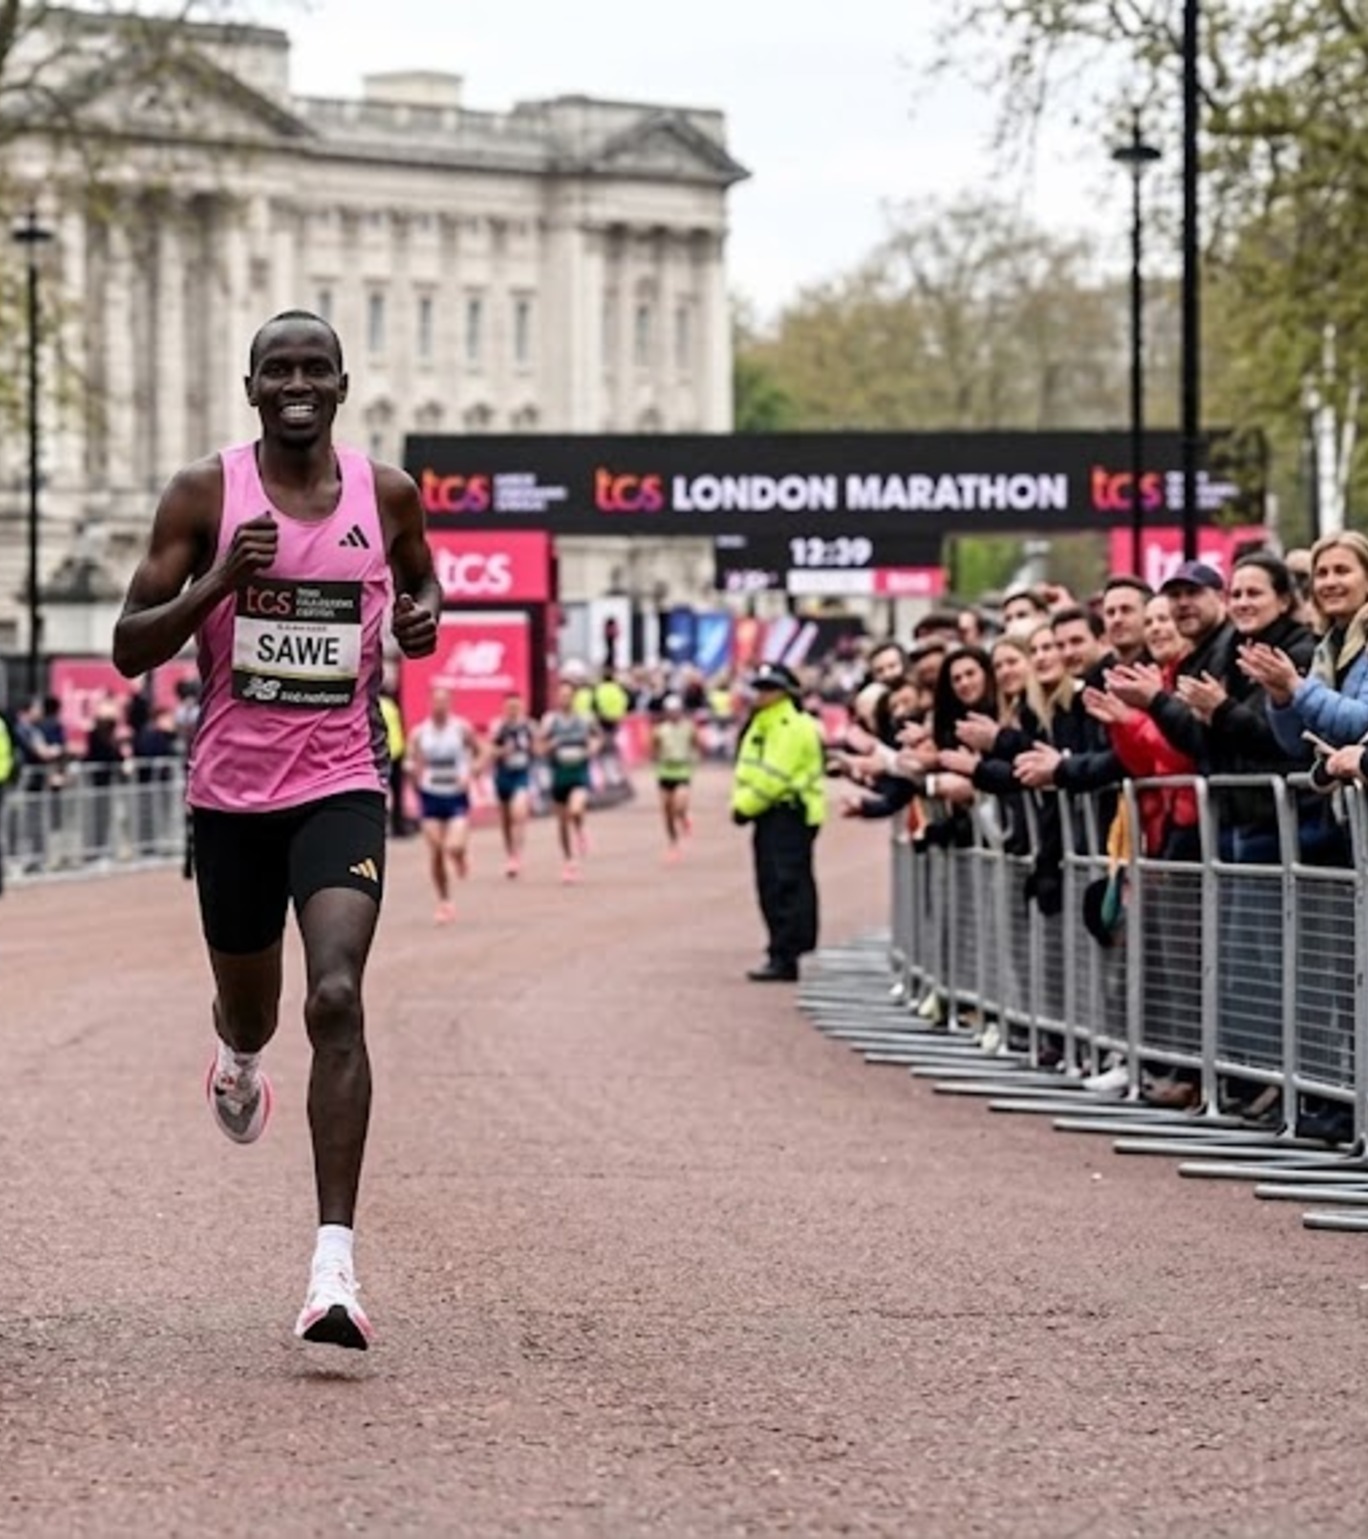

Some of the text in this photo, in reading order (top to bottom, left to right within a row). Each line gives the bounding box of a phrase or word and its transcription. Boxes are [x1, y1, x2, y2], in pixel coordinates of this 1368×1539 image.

[421, 469, 490, 512] tcs
[595, 468, 663, 511] tcs
[672, 475, 838, 511] LONDON
[845, 474, 1069, 510] MARATHON
[247, 586, 292, 615] tcs
[256, 634, 340, 665] SAWE
